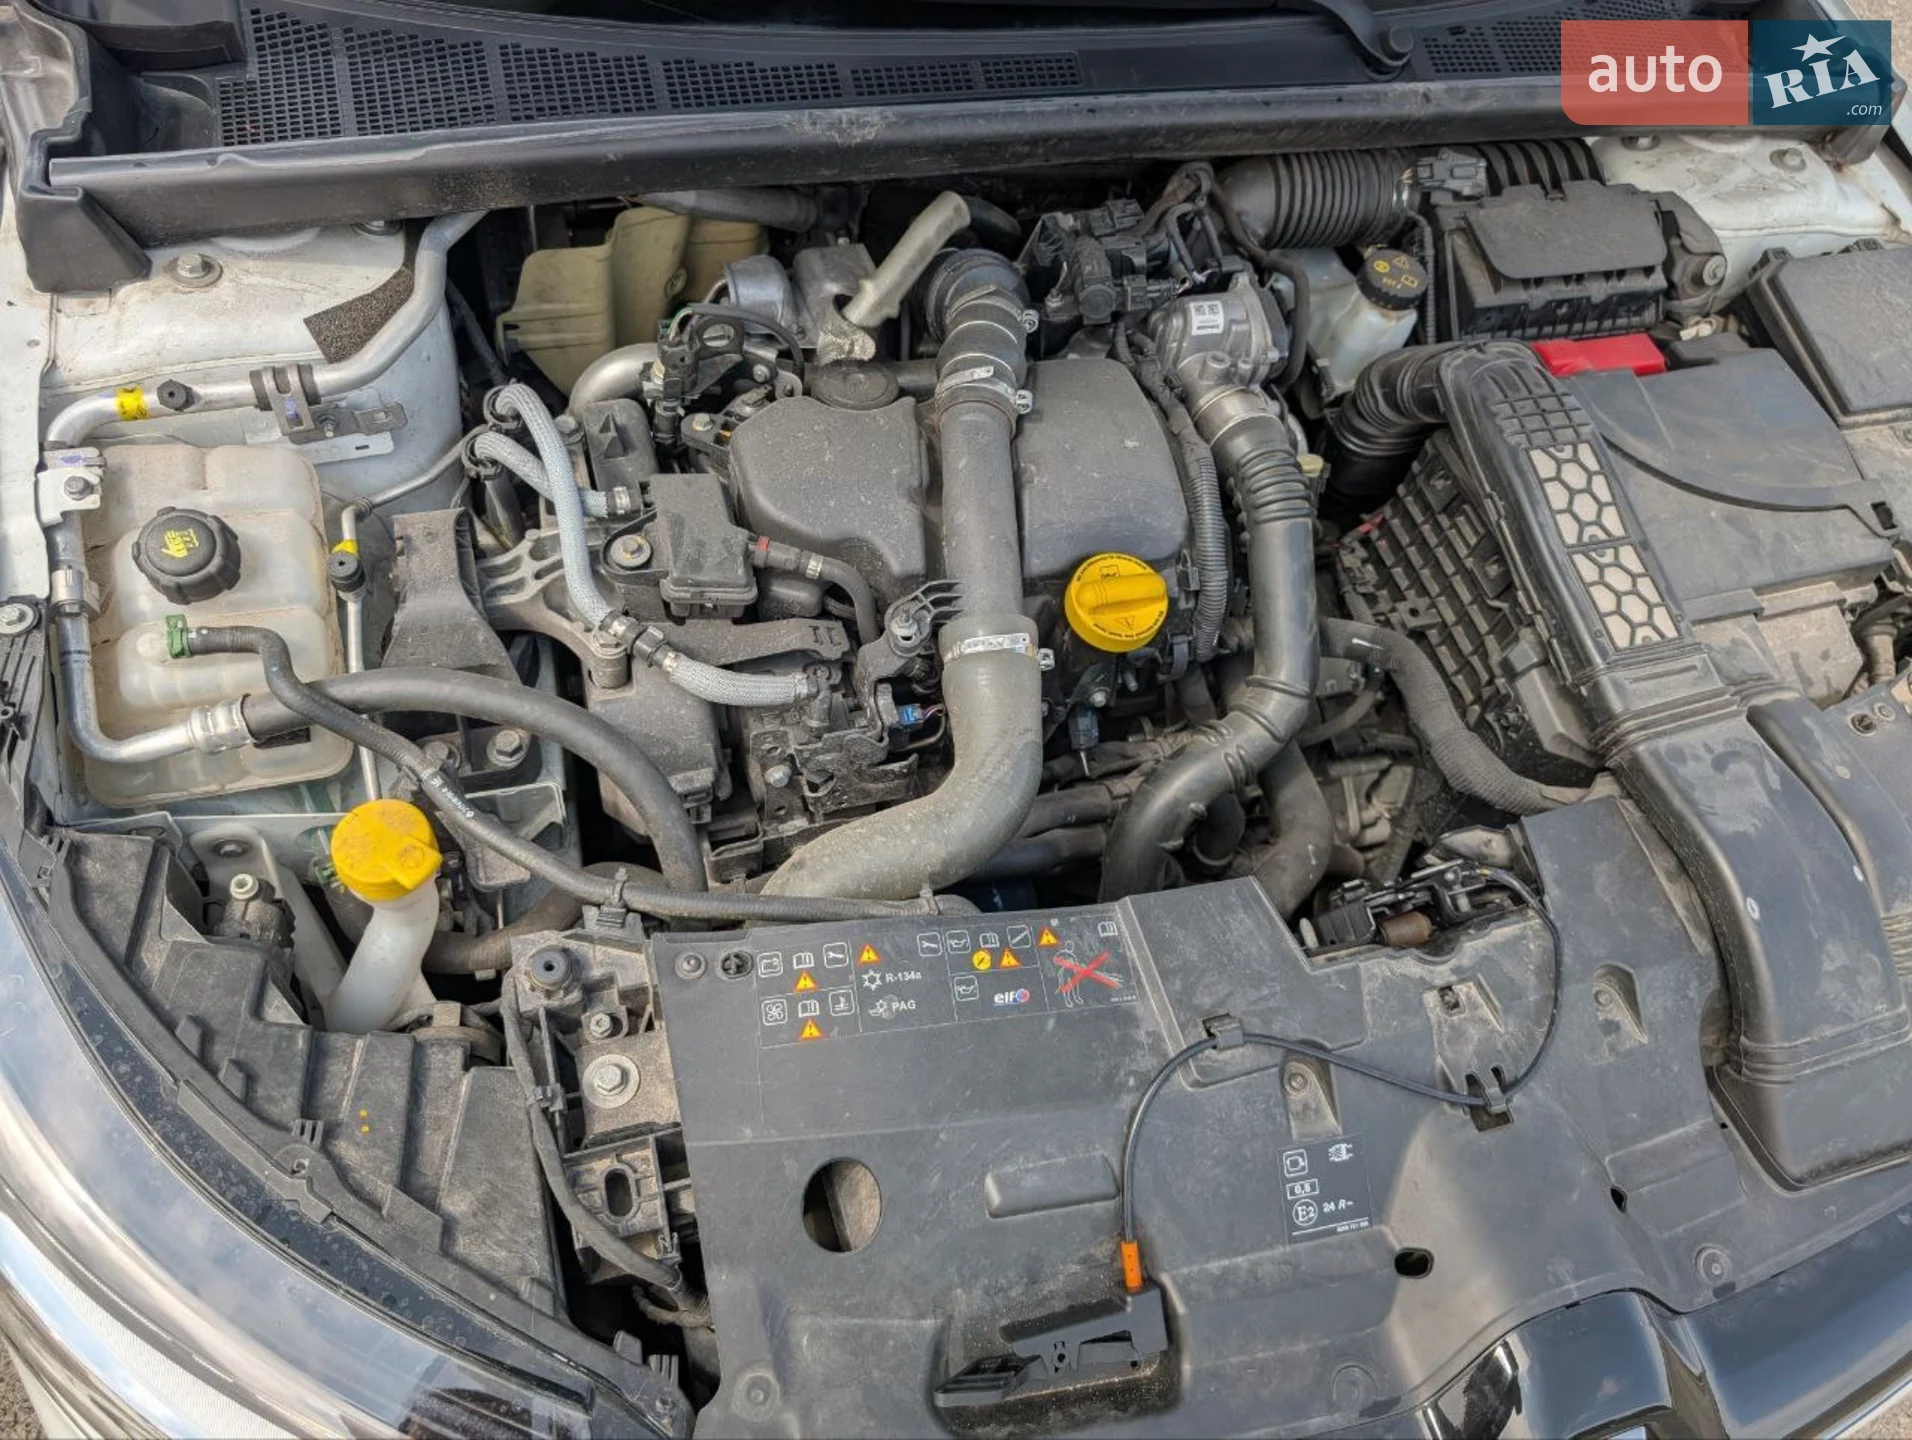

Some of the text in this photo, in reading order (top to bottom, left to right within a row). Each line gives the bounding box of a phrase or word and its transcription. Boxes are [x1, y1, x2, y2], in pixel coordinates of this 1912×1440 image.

[885, 970, 923, 983] R-134a
[994, 989, 1018, 1004] elf
[891, 999, 917, 1012] PAG
